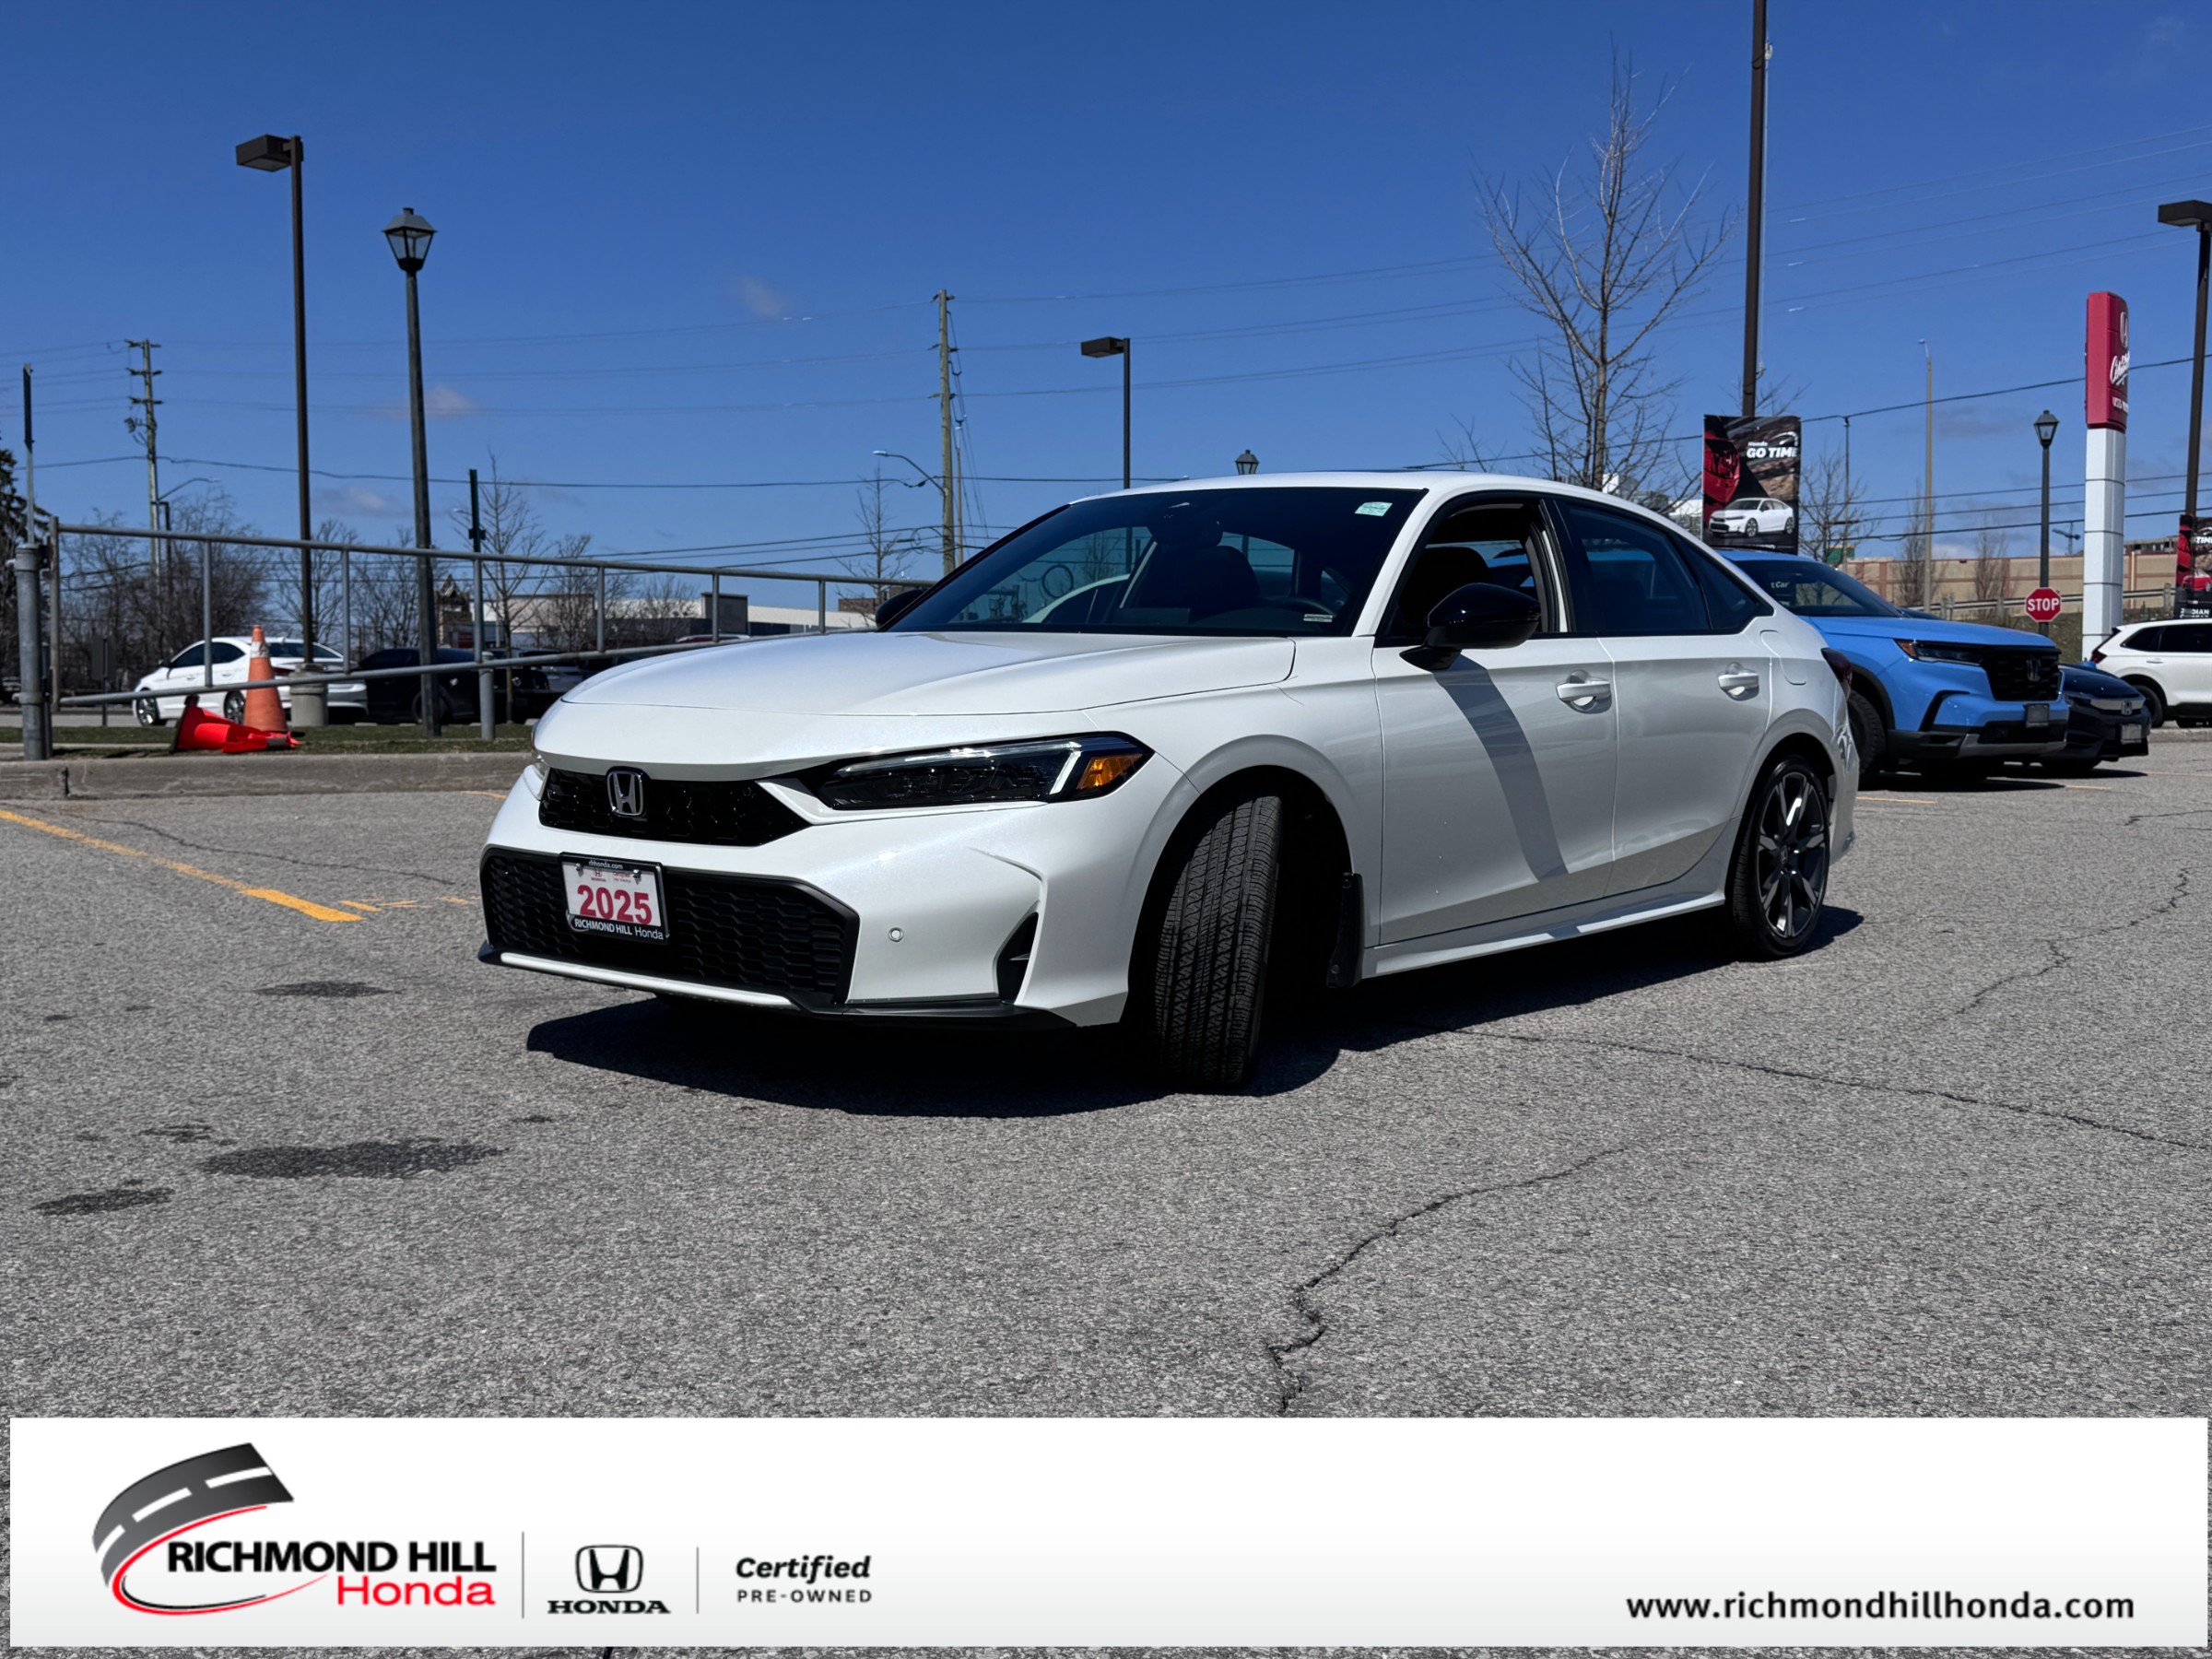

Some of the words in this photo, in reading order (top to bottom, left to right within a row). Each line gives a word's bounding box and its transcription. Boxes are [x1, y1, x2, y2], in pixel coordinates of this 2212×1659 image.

[1747, 447, 1767, 458] GO
[1768, 447, 1797, 458] TIME
[2195, 535, 2212, 544] TIM
[2028, 598, 2060, 612] STOP
[577, 885, 653, 925] 2025
[574, 918, 615, 933] RICHMOND
[615, 924, 633, 935] HILL
[634, 926, 664, 940] Honda
